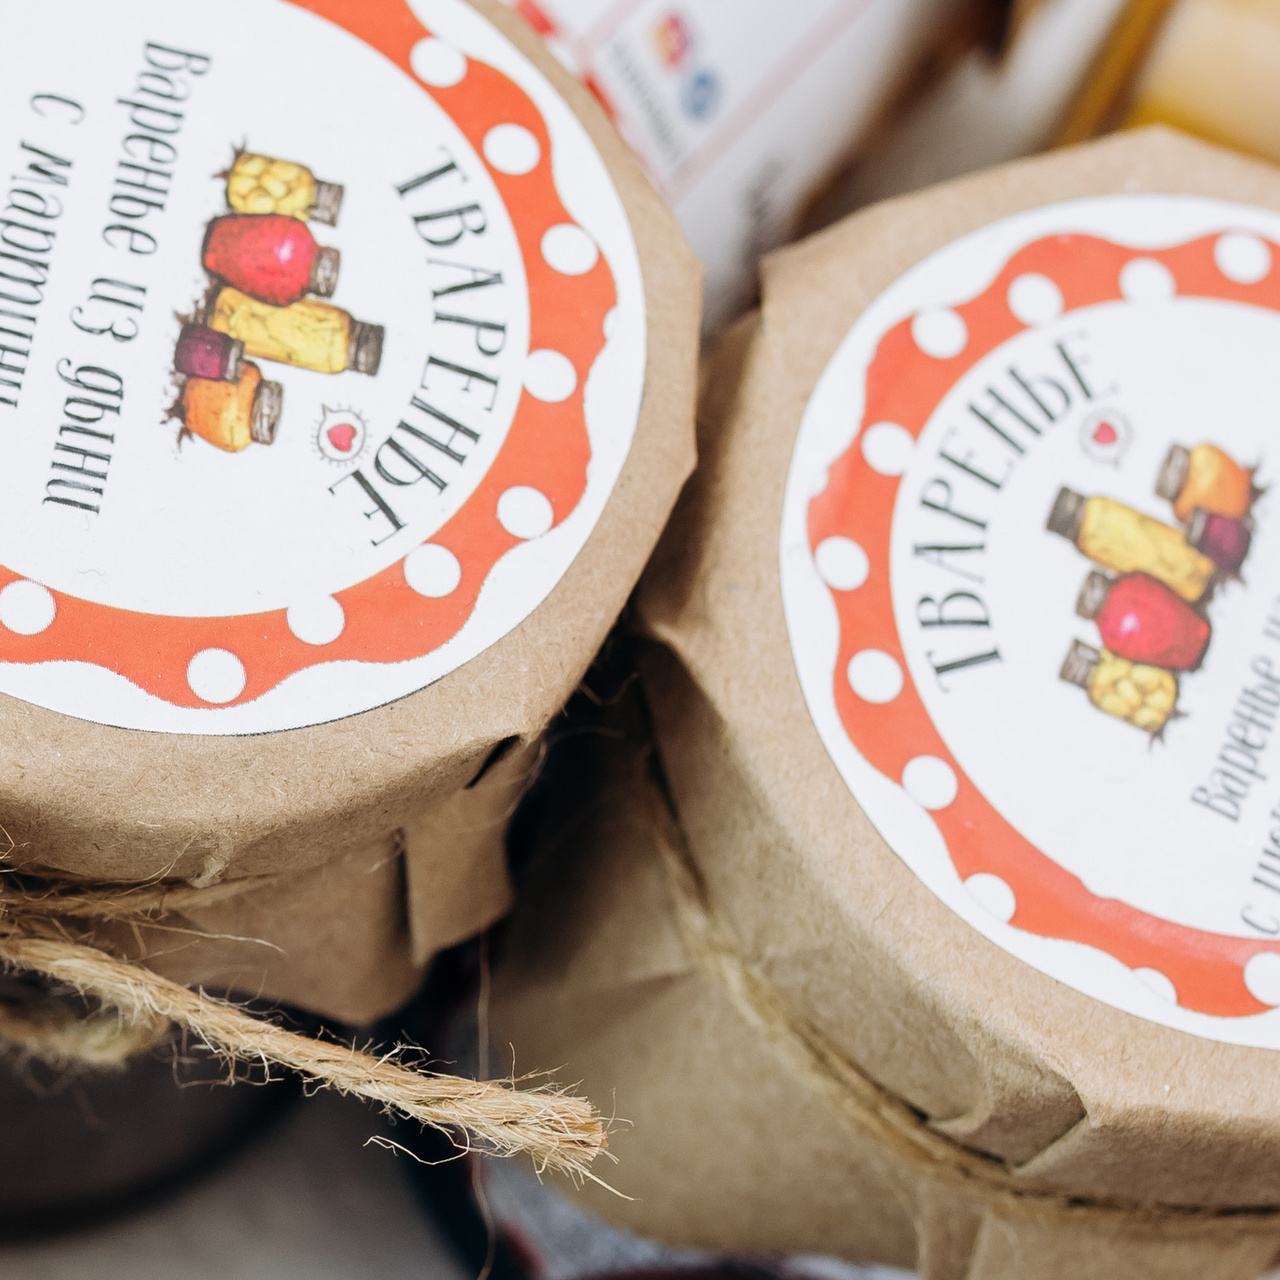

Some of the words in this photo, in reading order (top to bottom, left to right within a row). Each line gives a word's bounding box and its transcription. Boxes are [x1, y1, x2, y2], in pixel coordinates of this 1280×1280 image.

[101, 40, 212, 256] Варенье
[71, 276, 148, 344] из
[327, 144, 508, 547] ТВАРЕНЬЕ
[42, 357, 125, 515] дыни
[912, 332, 1117, 693] ТВАРЕНЬЕ
